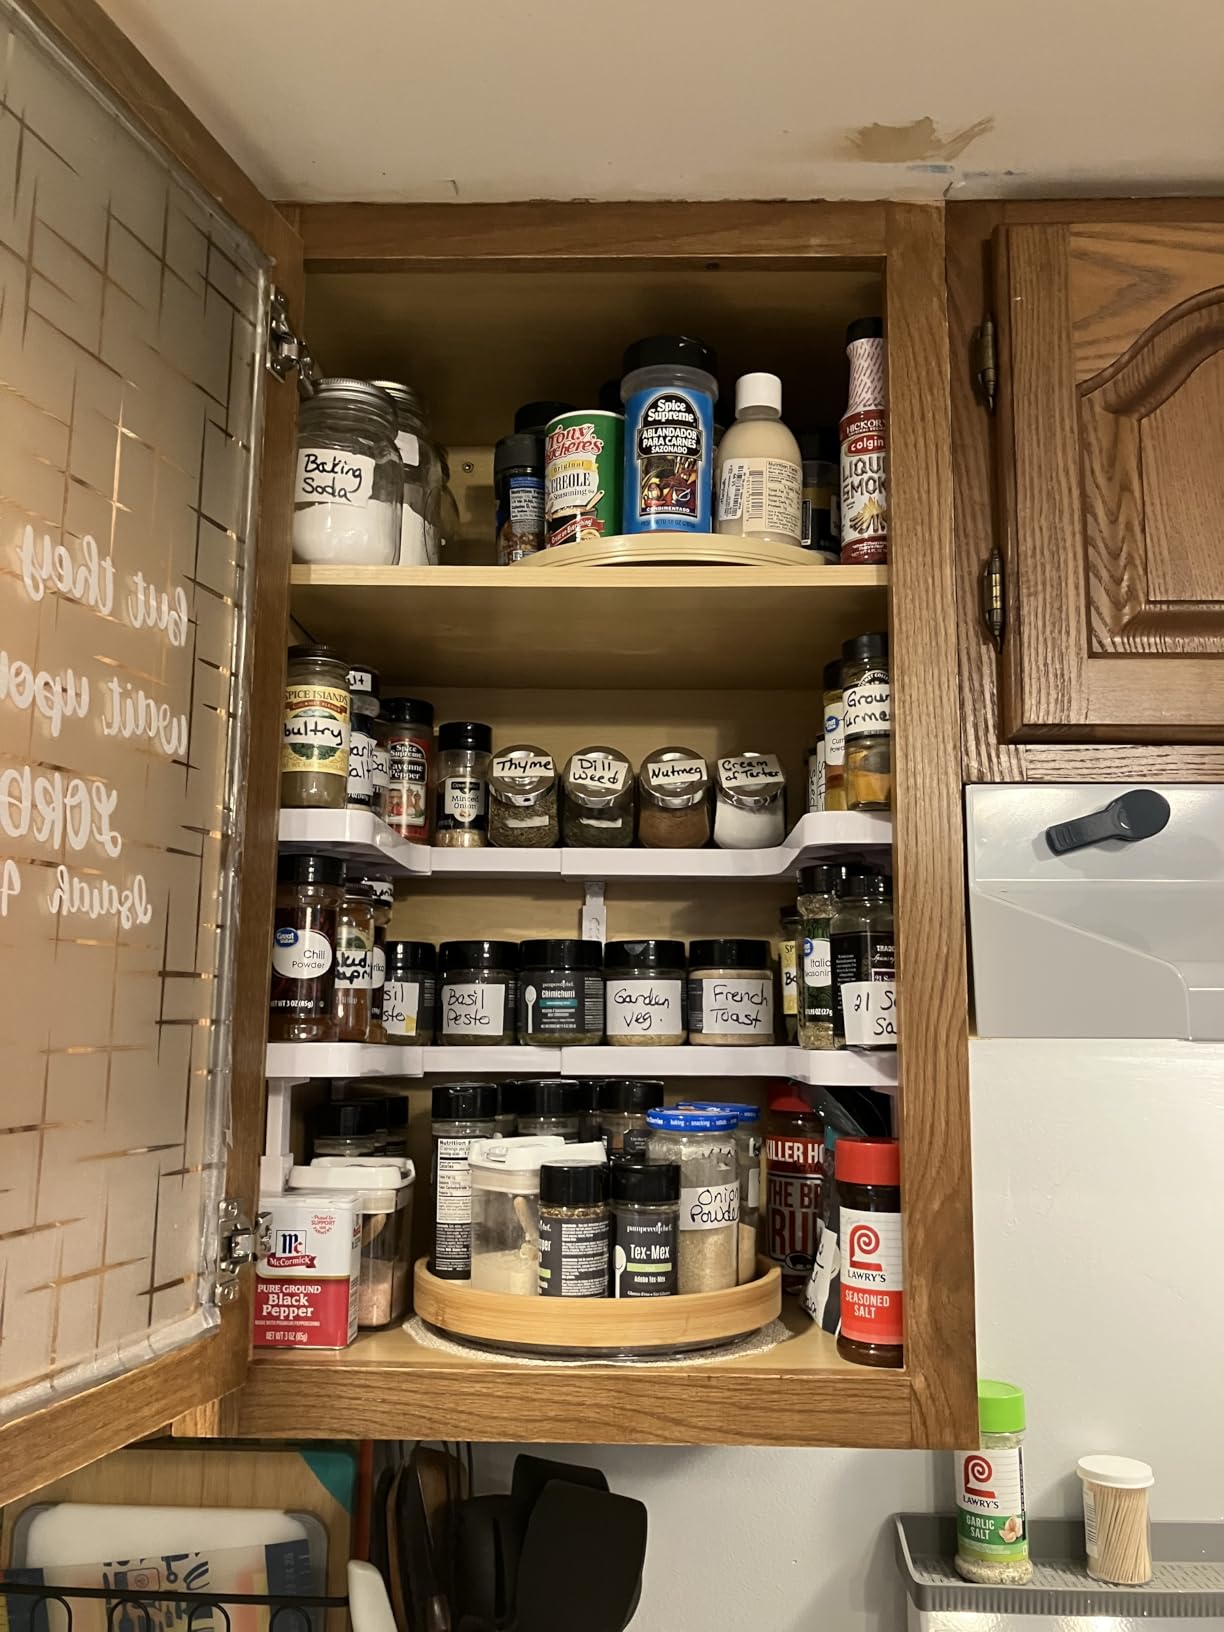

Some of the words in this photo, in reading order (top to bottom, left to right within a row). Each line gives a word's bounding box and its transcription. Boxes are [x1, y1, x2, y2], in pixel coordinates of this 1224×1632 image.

[657, 399, 686, 413] Spice
[647, 409, 695, 423] Supreme
[548, 424, 593, 450] Tony
[642, 427, 697, 440] ABLANDADOR
[642, 437, 665, 449] PARA
[666, 437, 697, 449] CARNES
[651, 445, 688, 454] SAZONADO
[850, 436, 884, 451] colgin
[304, 453, 362, 493] Baking
[302, 477, 352, 503] Soda
[551, 472, 591, 493] CREOLE
[312, 689, 348, 706] ISLANDS
[496, 758, 553, 775] Thyme
[578, 758, 611, 773] Dill
[722, 759, 768, 771] Cream
[573, 770, 619, 785] Weed
[651, 765, 703, 783] Nutmeg
[724, 772, 739, 781] of
[303, 949, 326, 960] Chili
[292, 961, 325, 969] Powder
[447, 988, 485, 1010] Basil
[614, 988, 670, 1008] Garden
[713, 982, 769, 1007] French
[854, 992, 870, 1012] 21
[447, 1008, 491, 1027] Pesto
[710, 1008, 763, 1028] Toast
[630, 1244, 670, 1260] Tex-Mex
[269, 1256, 311, 1267] McCormick
[847, 1269, 887, 1283] LAWRY'S
[257, 1284, 281, 1293] PURE
[282, 1285, 322, 1293] GROUND
[268, 1293, 309, 1306] Black
[845, 1290, 890, 1307] SEASONED
[262, 1305, 314, 1320] Pepper
[854, 1304, 876, 1319] SALT
[265, 1331, 275, 1340] NET
[276, 1331, 284, 1340] WT
[285, 1331, 288, 1340] 3
[289, 1331, 296, 1340] OZ
[963, 1494, 999, 1509] LAWRY'S
[966, 1514, 995, 1530] GARLIC
[970, 1526, 990, 1540] SALT
